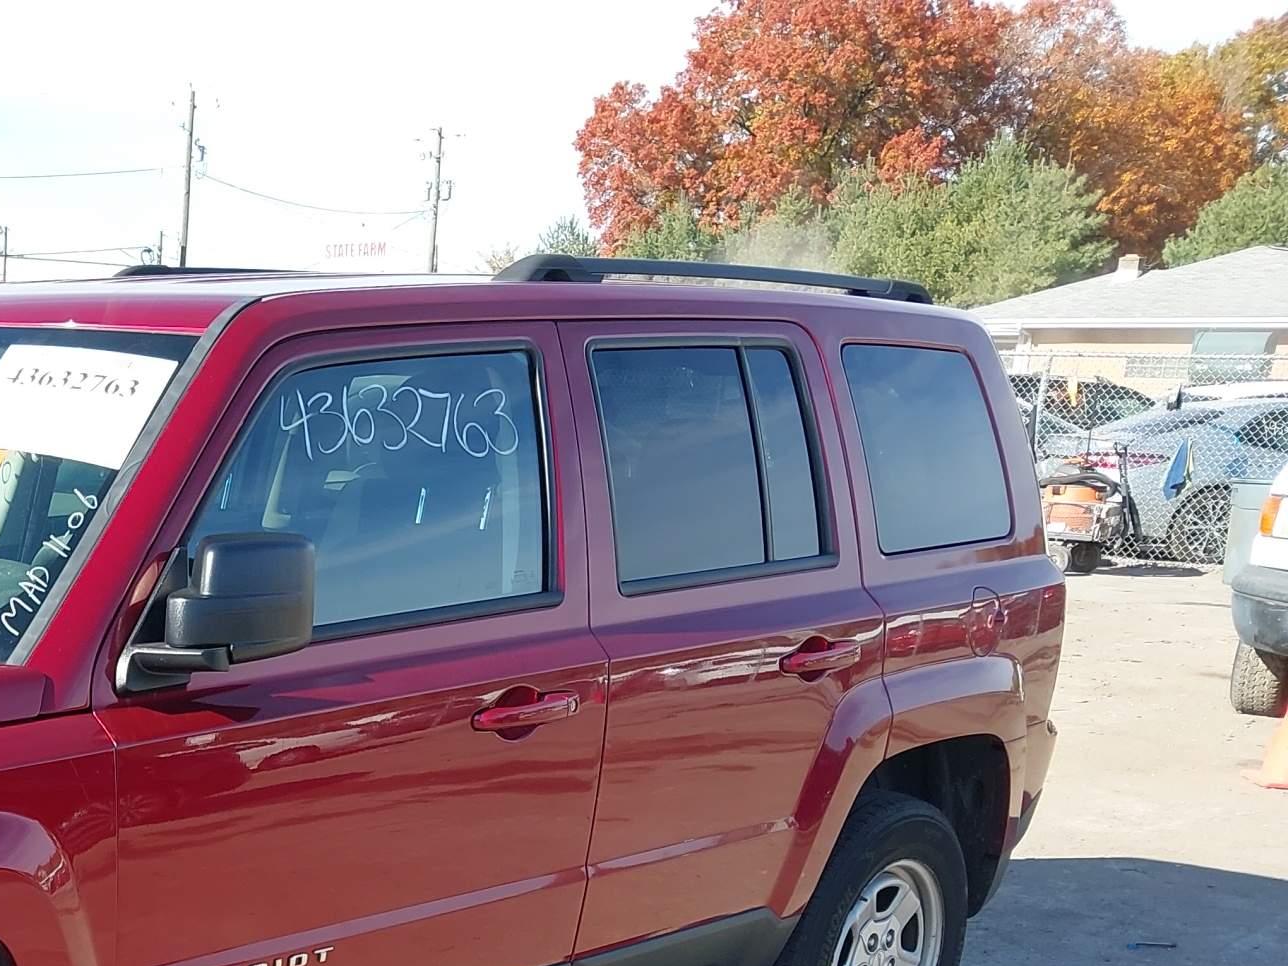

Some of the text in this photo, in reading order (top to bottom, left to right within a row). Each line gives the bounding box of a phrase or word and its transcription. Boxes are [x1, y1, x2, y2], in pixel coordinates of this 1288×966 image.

[325, 241, 387, 259] STATE FARM
[7, 367, 140, 397] 43632763
[279, 384, 519, 462] 43632763
[0, 566, 50, 637] MAD
